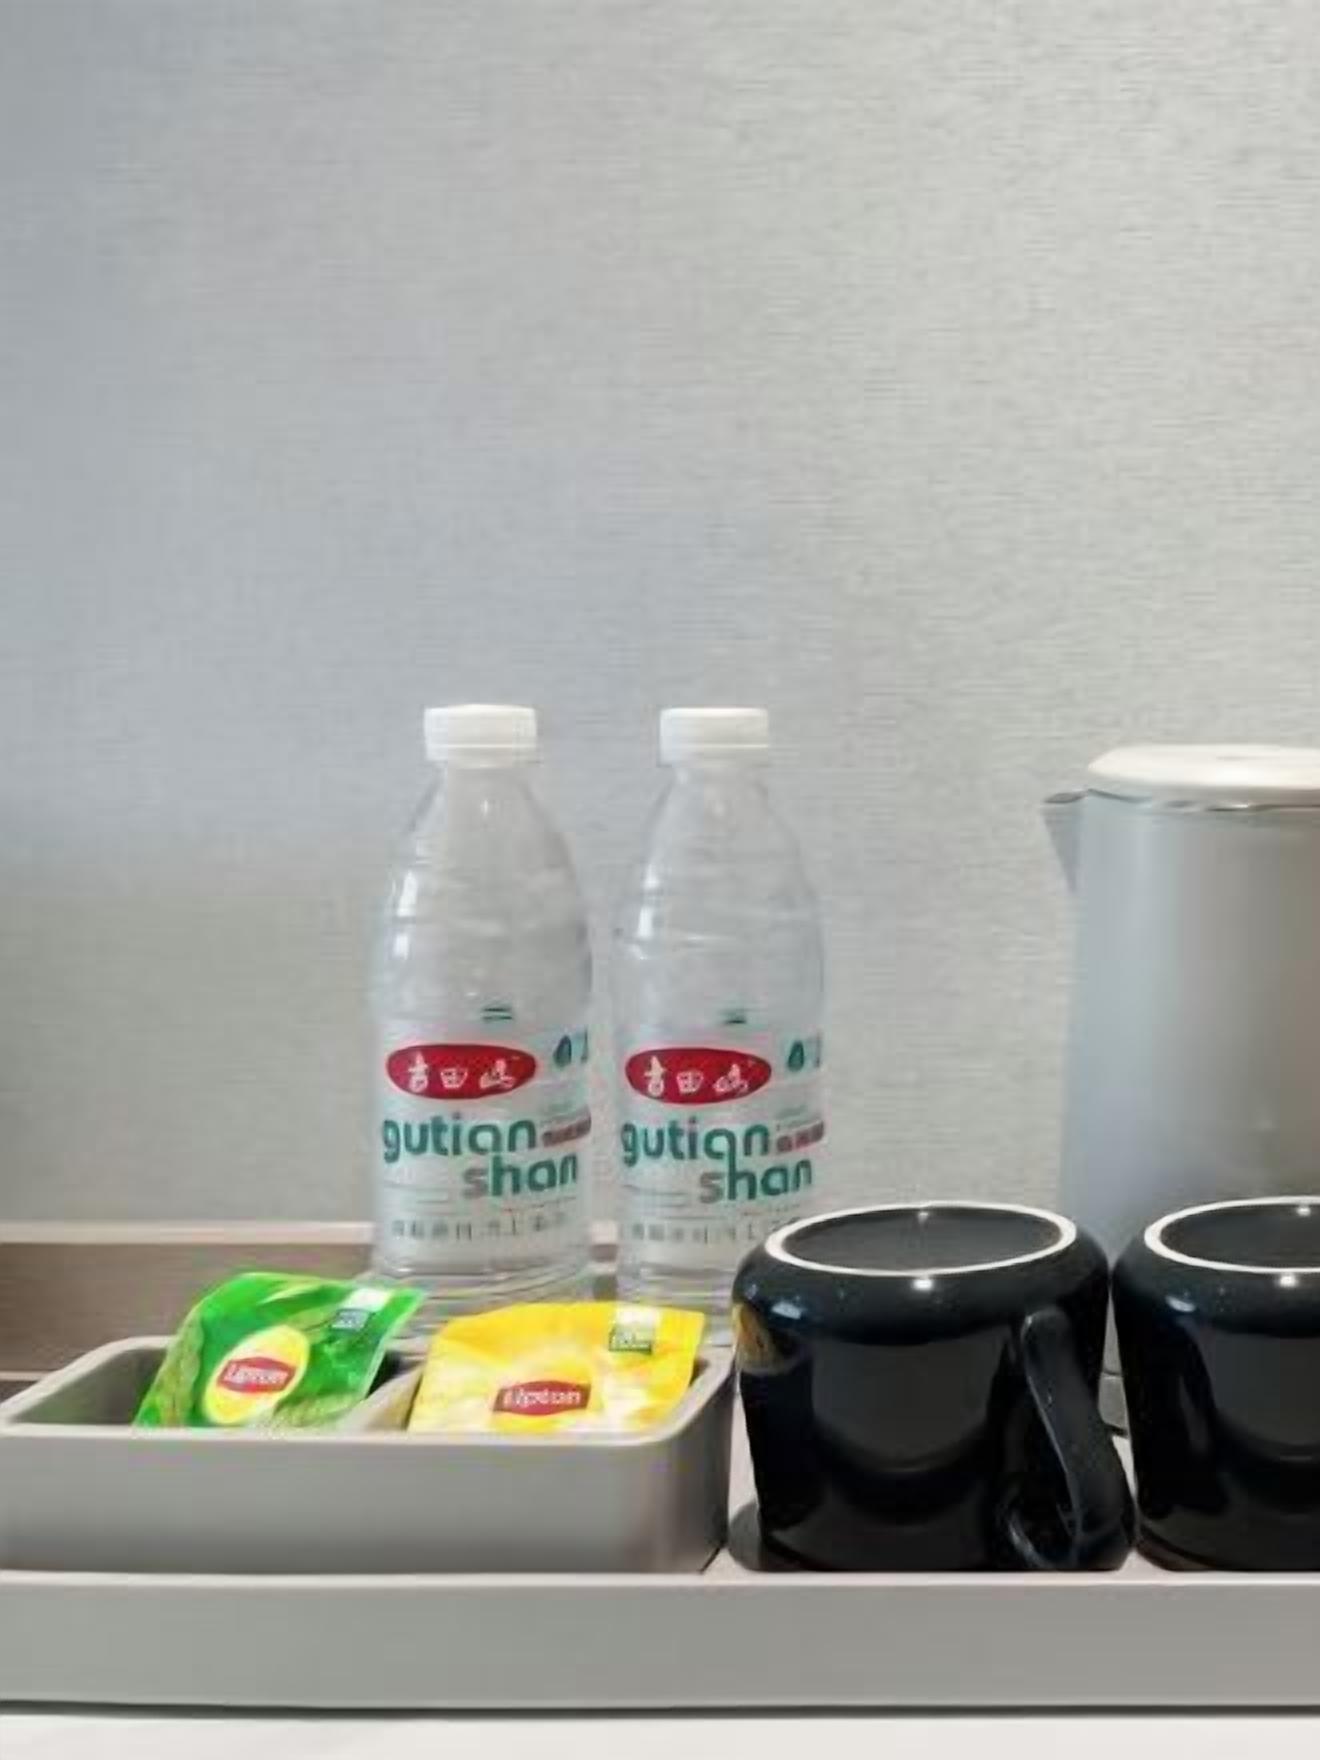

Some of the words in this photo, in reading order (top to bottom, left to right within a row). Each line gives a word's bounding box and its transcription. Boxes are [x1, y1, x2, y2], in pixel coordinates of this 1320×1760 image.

[383, 1111, 537, 1163] gutian
[621, 1116, 770, 1167] gutian
[462, 1154, 578, 1198] shan
[699, 1158, 812, 1203] shan
